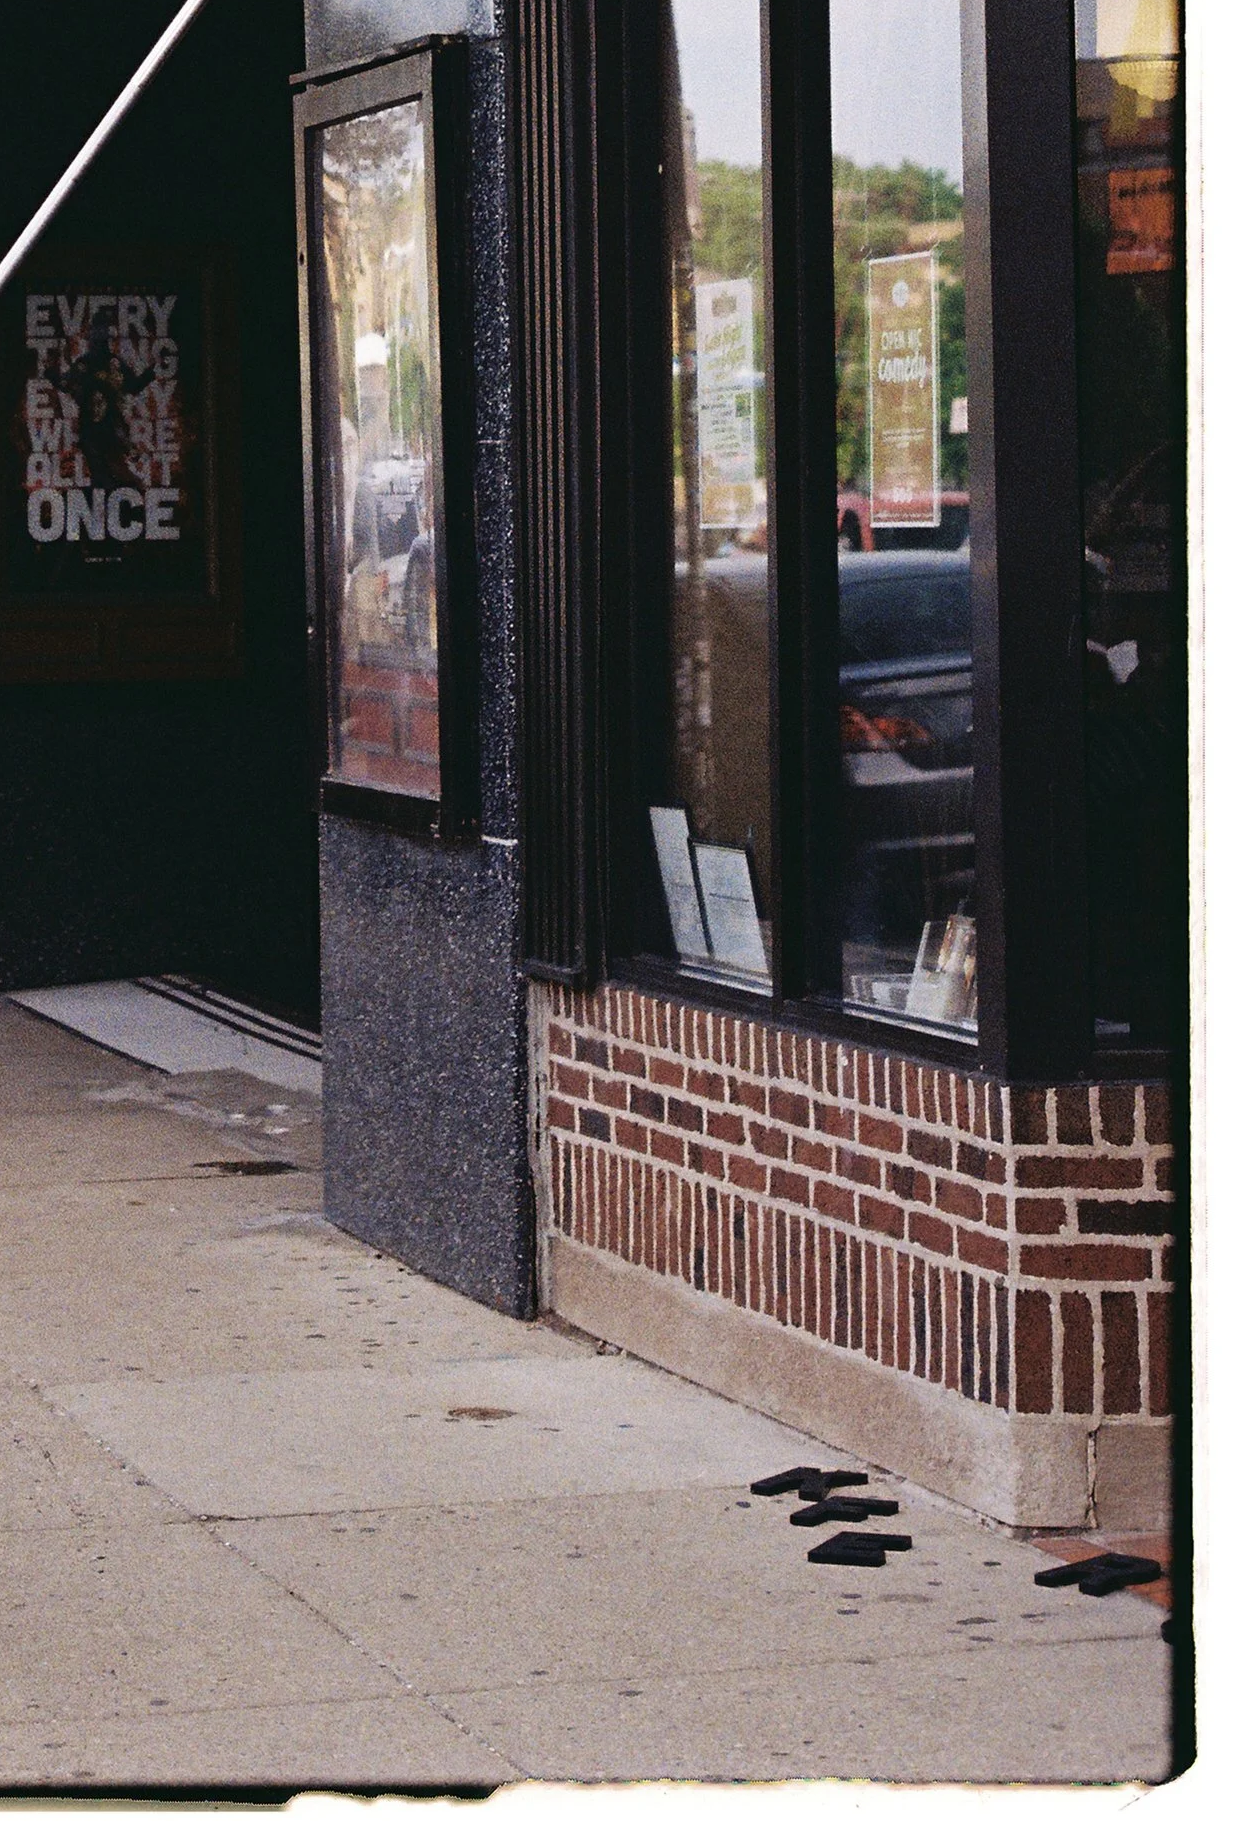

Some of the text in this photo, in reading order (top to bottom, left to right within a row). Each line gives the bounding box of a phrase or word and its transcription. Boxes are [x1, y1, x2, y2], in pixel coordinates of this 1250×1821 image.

[26, 338, 179, 379] TNG
[877, 352, 927, 388] comedy
[26, 487, 180, 542] ONCE
